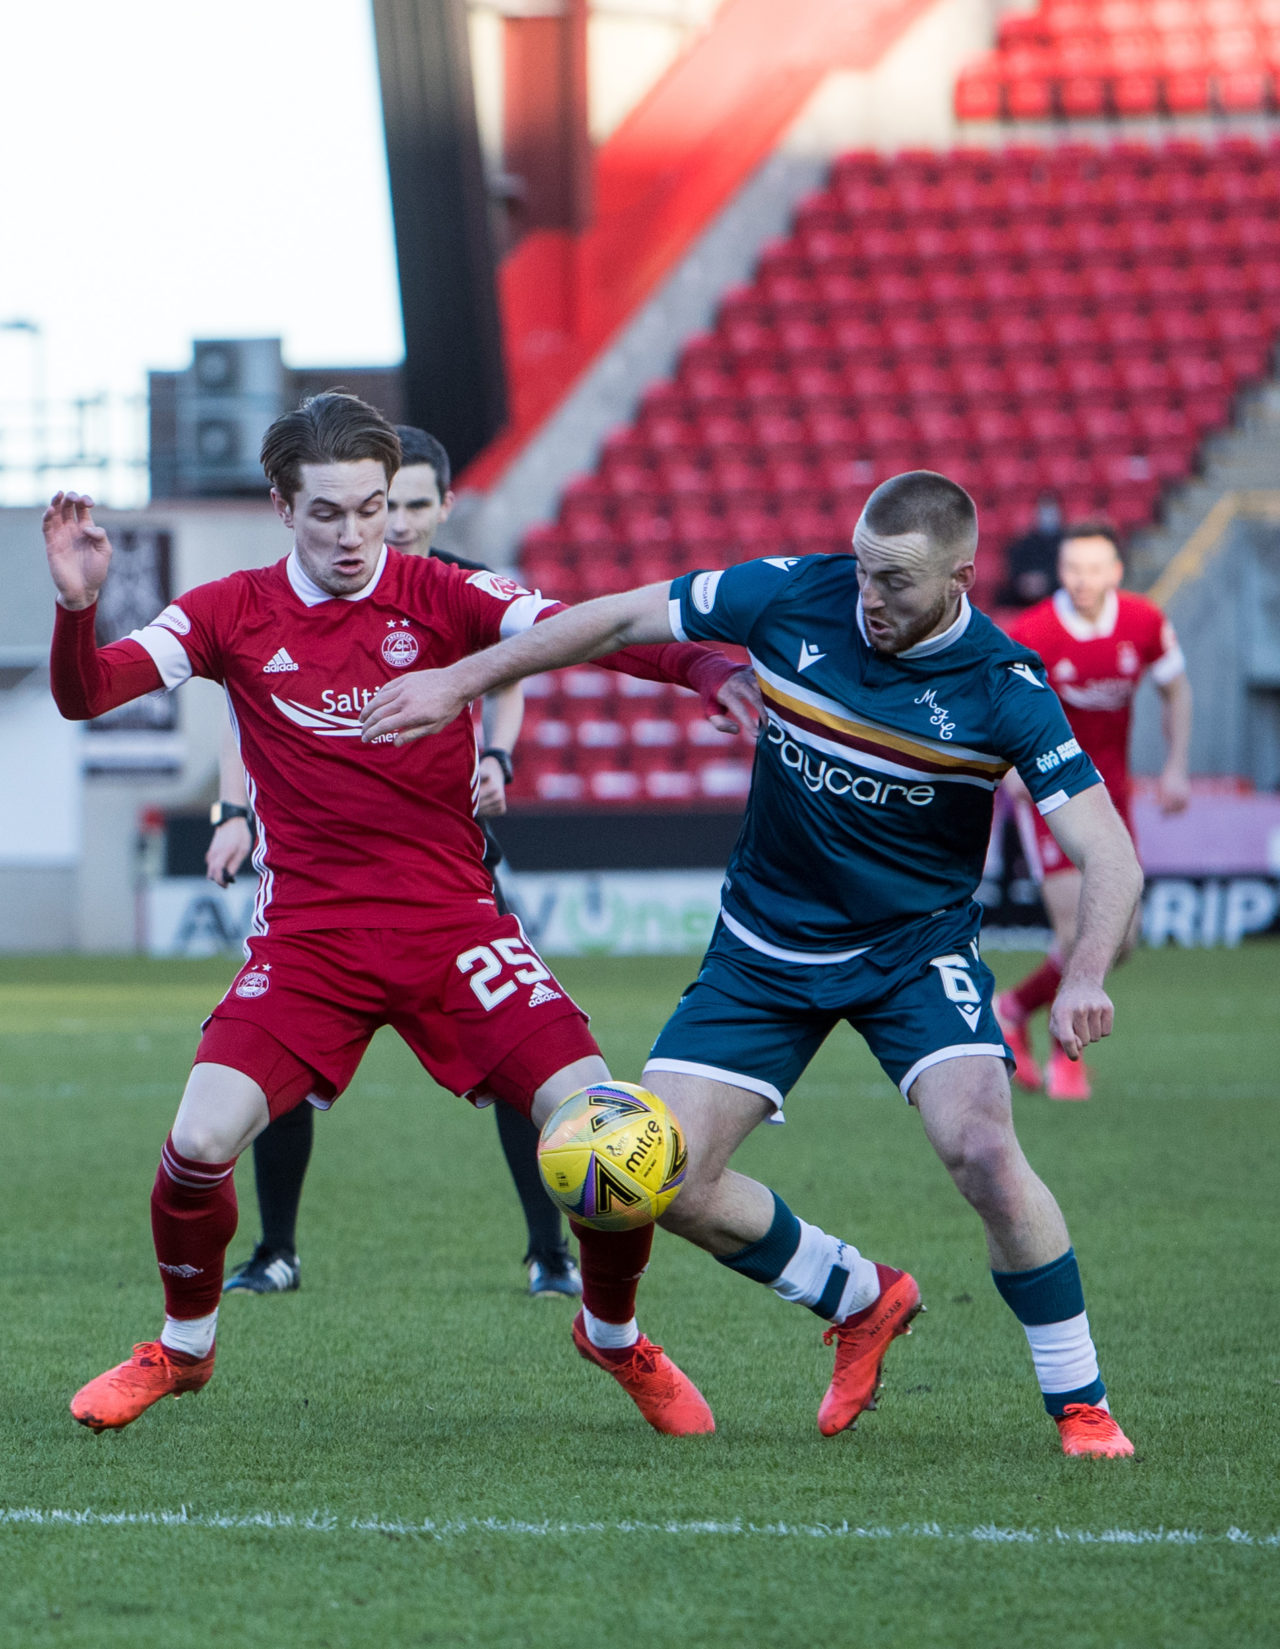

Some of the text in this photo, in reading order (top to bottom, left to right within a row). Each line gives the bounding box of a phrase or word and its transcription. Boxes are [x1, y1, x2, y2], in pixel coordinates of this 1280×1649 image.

[263, 662, 300, 673] adidas
[321, 686, 382, 714] Salti
[370, 730, 400, 744] ener
[456, 937, 551, 1012] 25
[929, 953, 982, 1004] 6
[528, 991, 562, 1008] adidas
[625, 1120, 660, 1173] mitre
